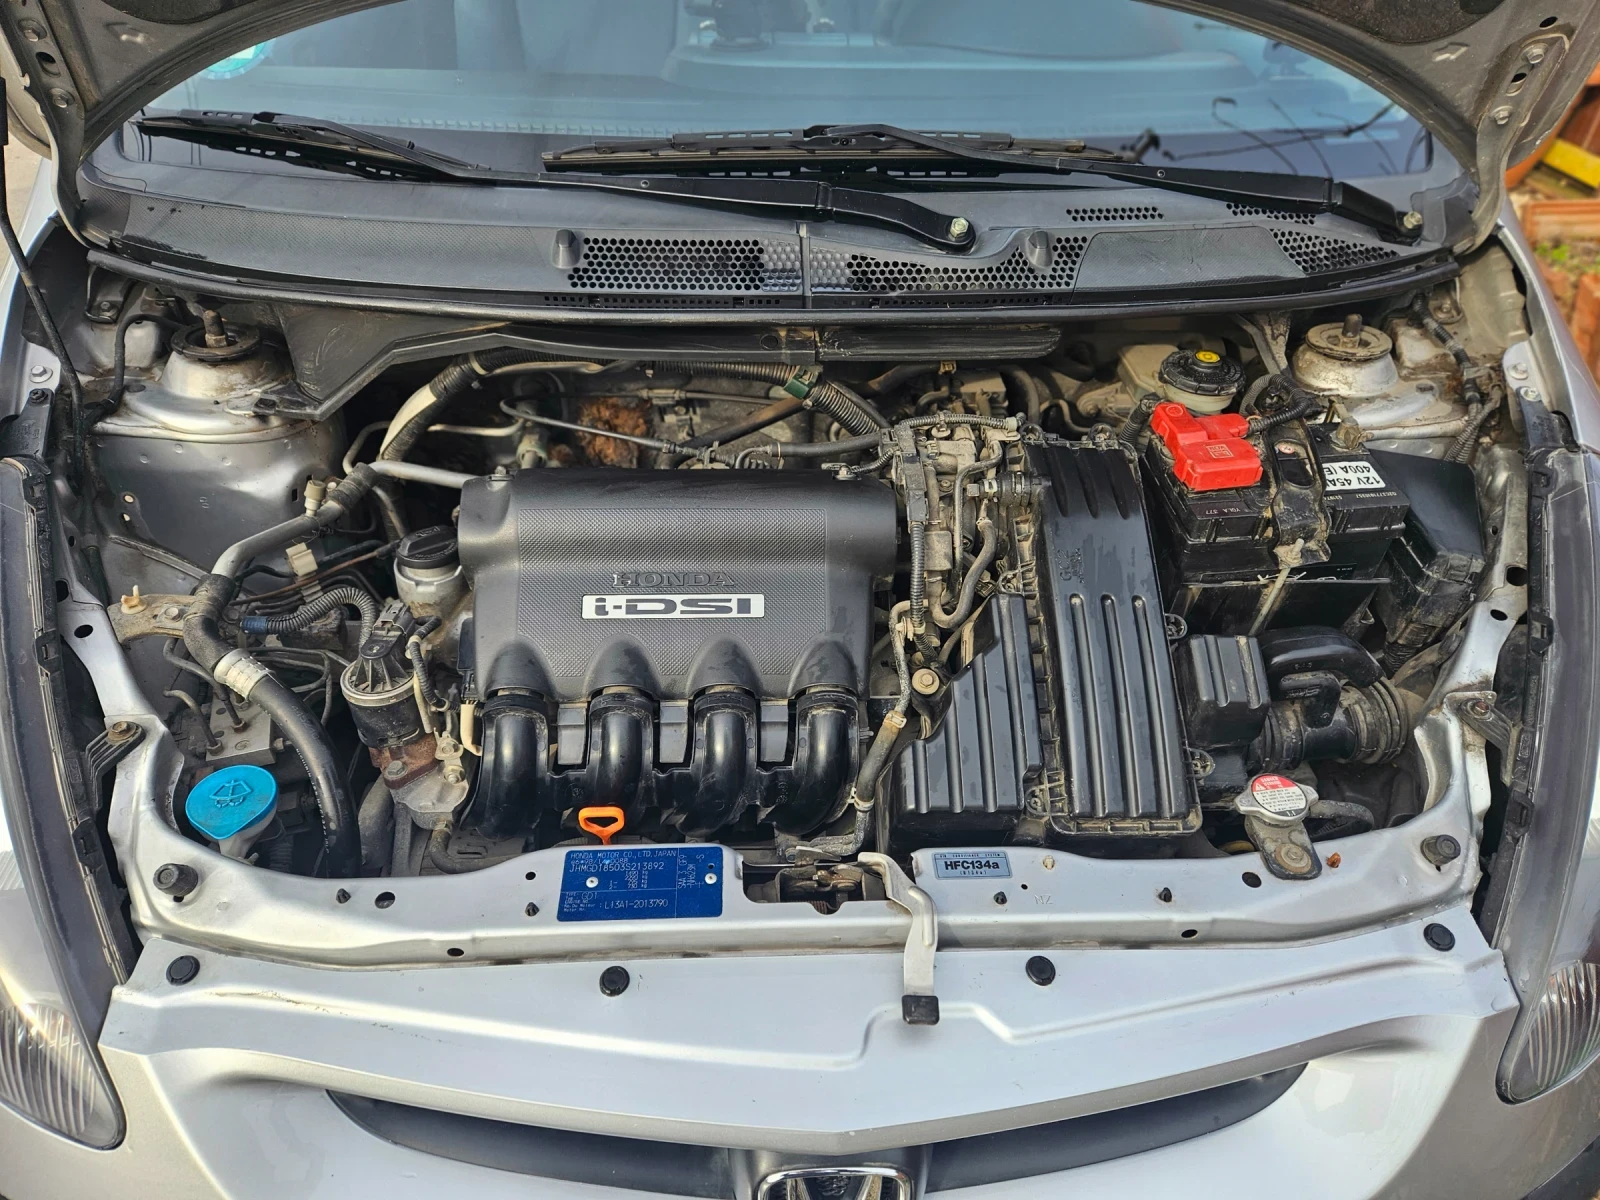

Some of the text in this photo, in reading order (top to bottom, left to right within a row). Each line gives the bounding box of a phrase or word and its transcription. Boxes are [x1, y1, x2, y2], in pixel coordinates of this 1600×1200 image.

[1323, 464, 1371, 477] 400A (E
[1325, 475, 1381, 488] 12V 45A
[612, 571, 735, 588] HONDA
[594, 597, 752, 617] i-DSI
[944, 860, 1000, 870] HFC134a
[581, 892, 597, 900] GD1
[1034, 894, 1053, 905] NZ
[604, 899, 669, 910] L13A1-2013790
